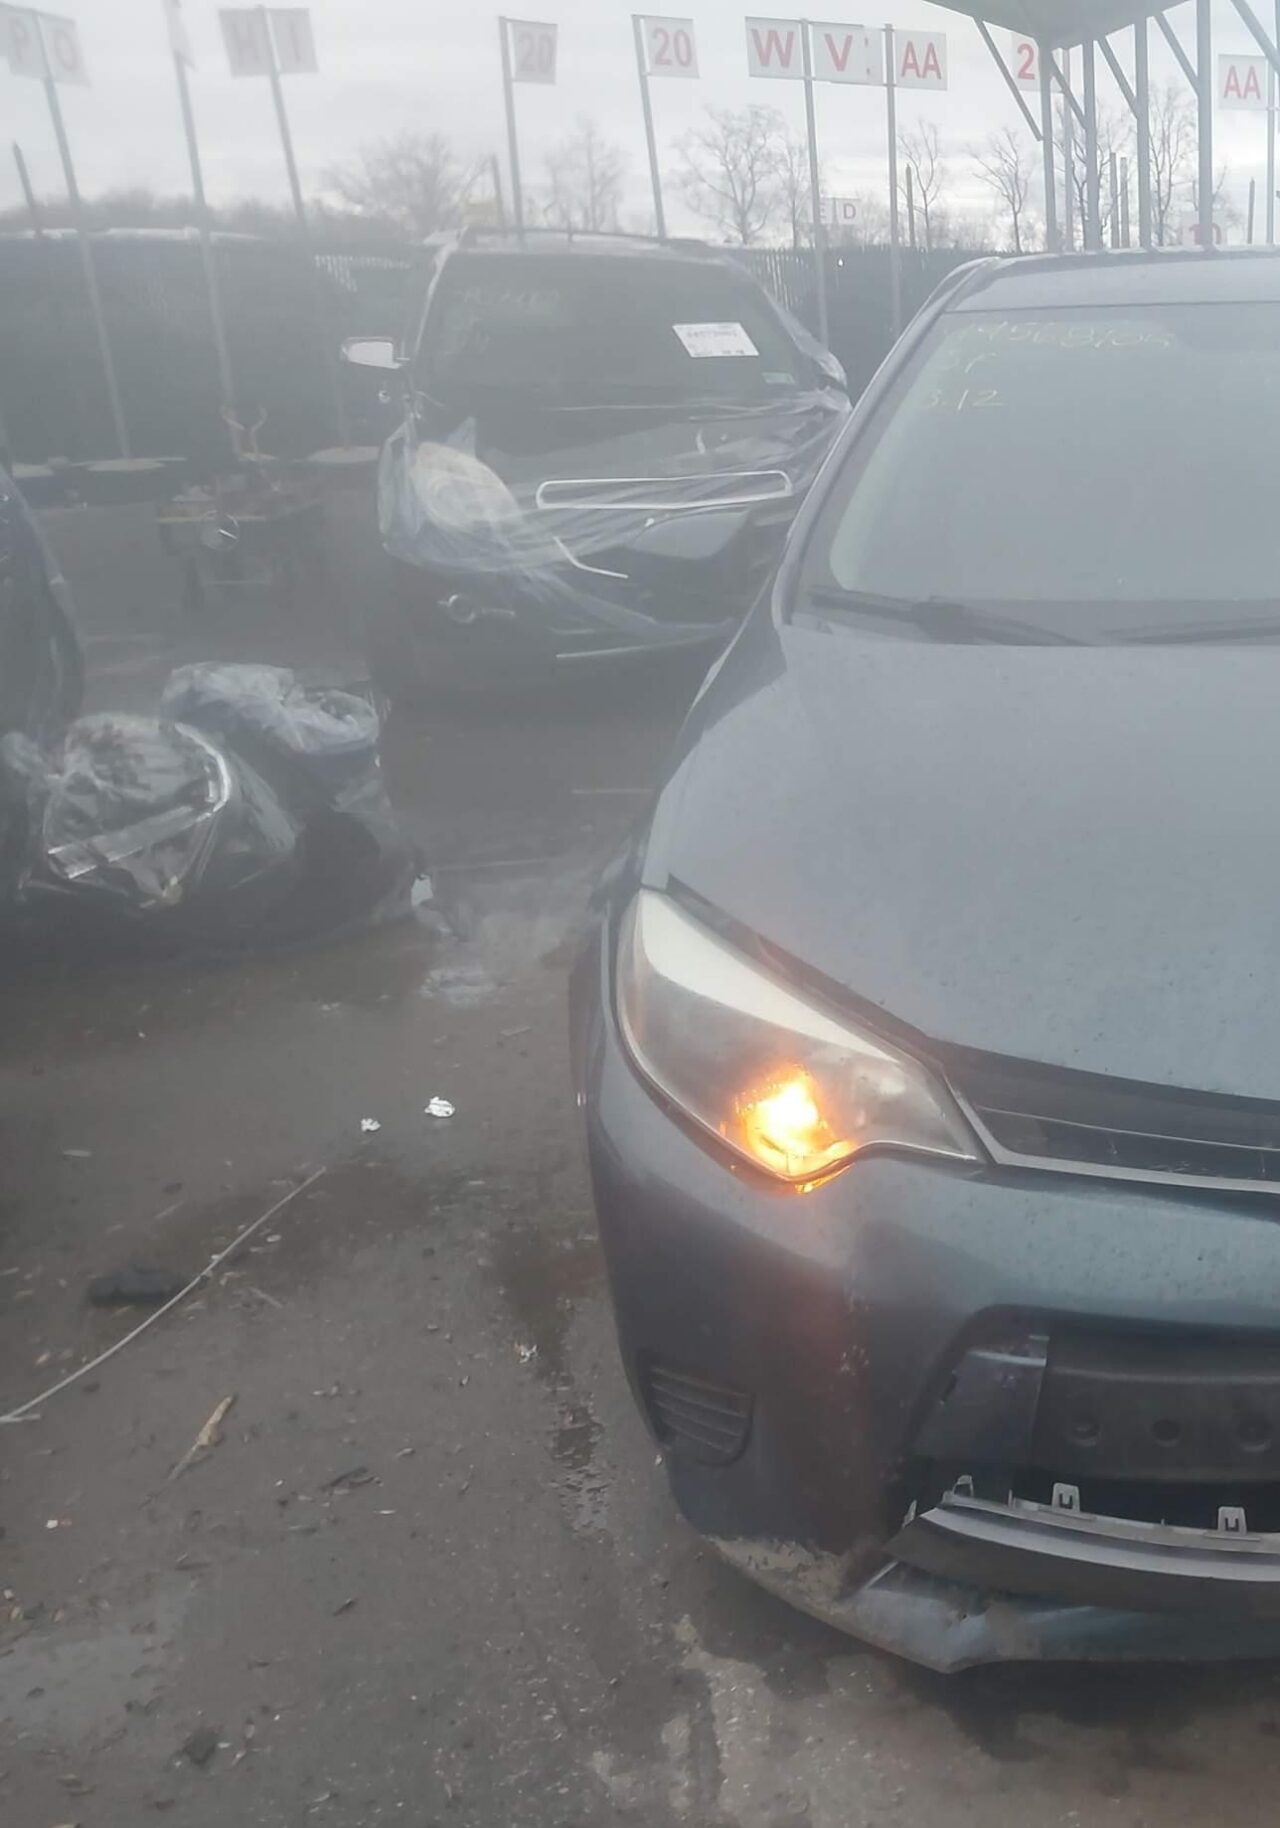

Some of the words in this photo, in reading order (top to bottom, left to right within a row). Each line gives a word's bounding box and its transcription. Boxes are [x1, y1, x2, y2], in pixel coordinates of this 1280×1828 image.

[652, 27, 693, 68] 20
[750, 28, 795, 68] W
[824, 33, 854, 72] V
[900, 40, 942, 80] AA
[1223, 65, 1261, 101] AA
[842, 202, 857, 219] D
